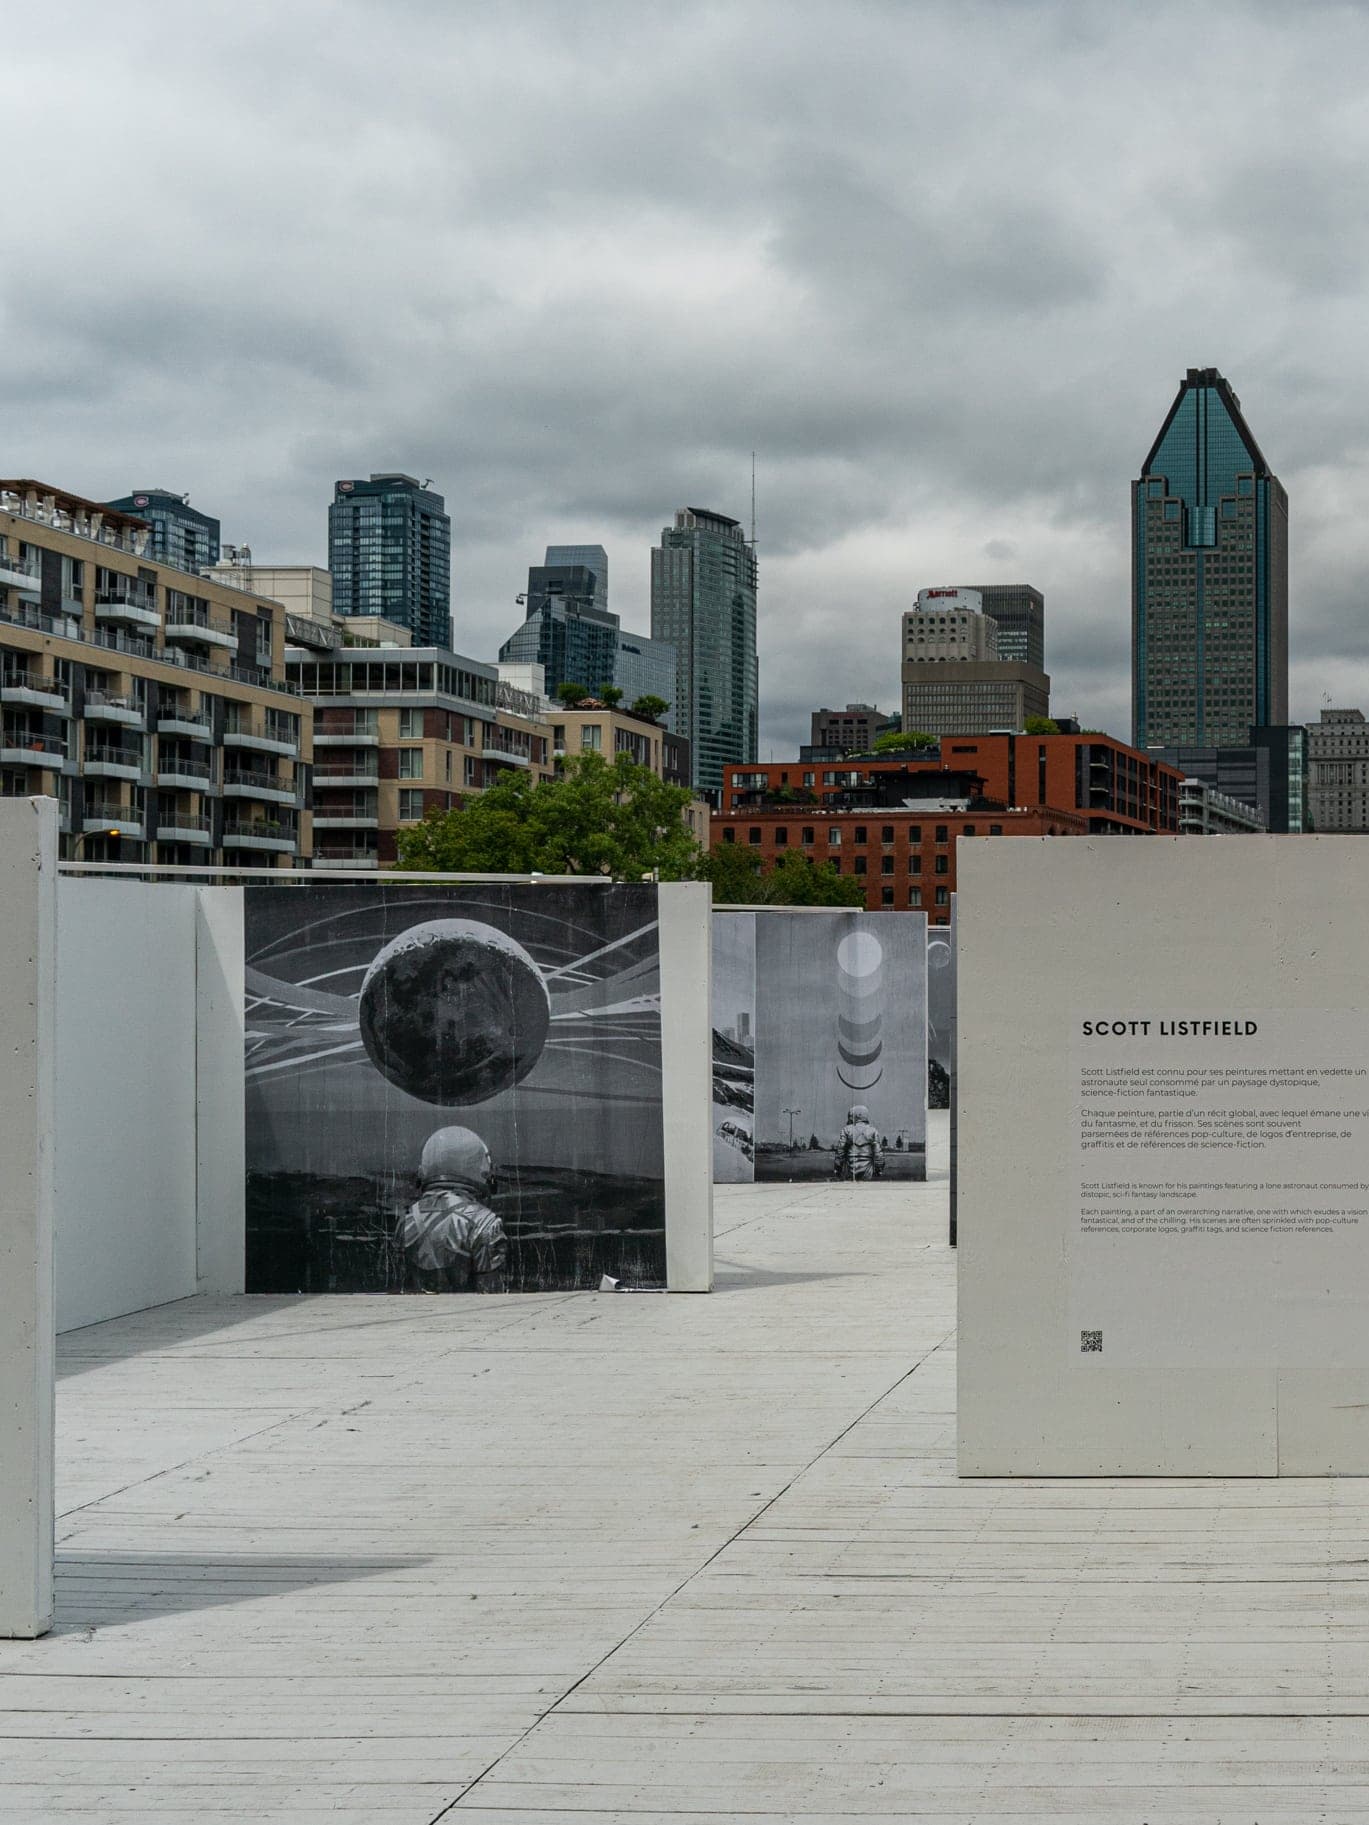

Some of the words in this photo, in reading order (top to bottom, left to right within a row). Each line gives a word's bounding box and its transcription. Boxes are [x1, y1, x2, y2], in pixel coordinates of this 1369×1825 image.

[1082, 1021, 1152, 1037] SCOTT
[1160, 1021, 1258, 1037] LISTFIELD
[1225, 1068, 1267, 1077] peintures
[1130, 1078, 1148, 1086] seul
[1149, 1078, 1199, 1086] consommé
[1081, 1109, 1116, 1118] Chaque
[1158, 1109, 1184, 1118] partie
[1186, 1109, 1206, 1117] d'un
[1207, 1109, 1227, 1117] récit
[1281, 1109, 1309, 1118] lequel
[1310, 1109, 1341, 1117] émane
[1081, 1130, 1129, 1139] parsemées
[1130, 1130, 1142, 1138] de
[1144, 1130, 1190, 1138] références
[1246, 1130, 1258, 1138] de
[1259, 1130, 1283, 1139] logos
[1340, 1130, 1352, 1138] de
[1081, 1141, 1114, 1150] graffitis
[1188, 1182, 1223, 1190] paintings
[1224, 1182, 1258, 1190] featuring
[1360, 1182, 1369, 1190] by
[1131, 1191, 1158, 1199] fantasy
